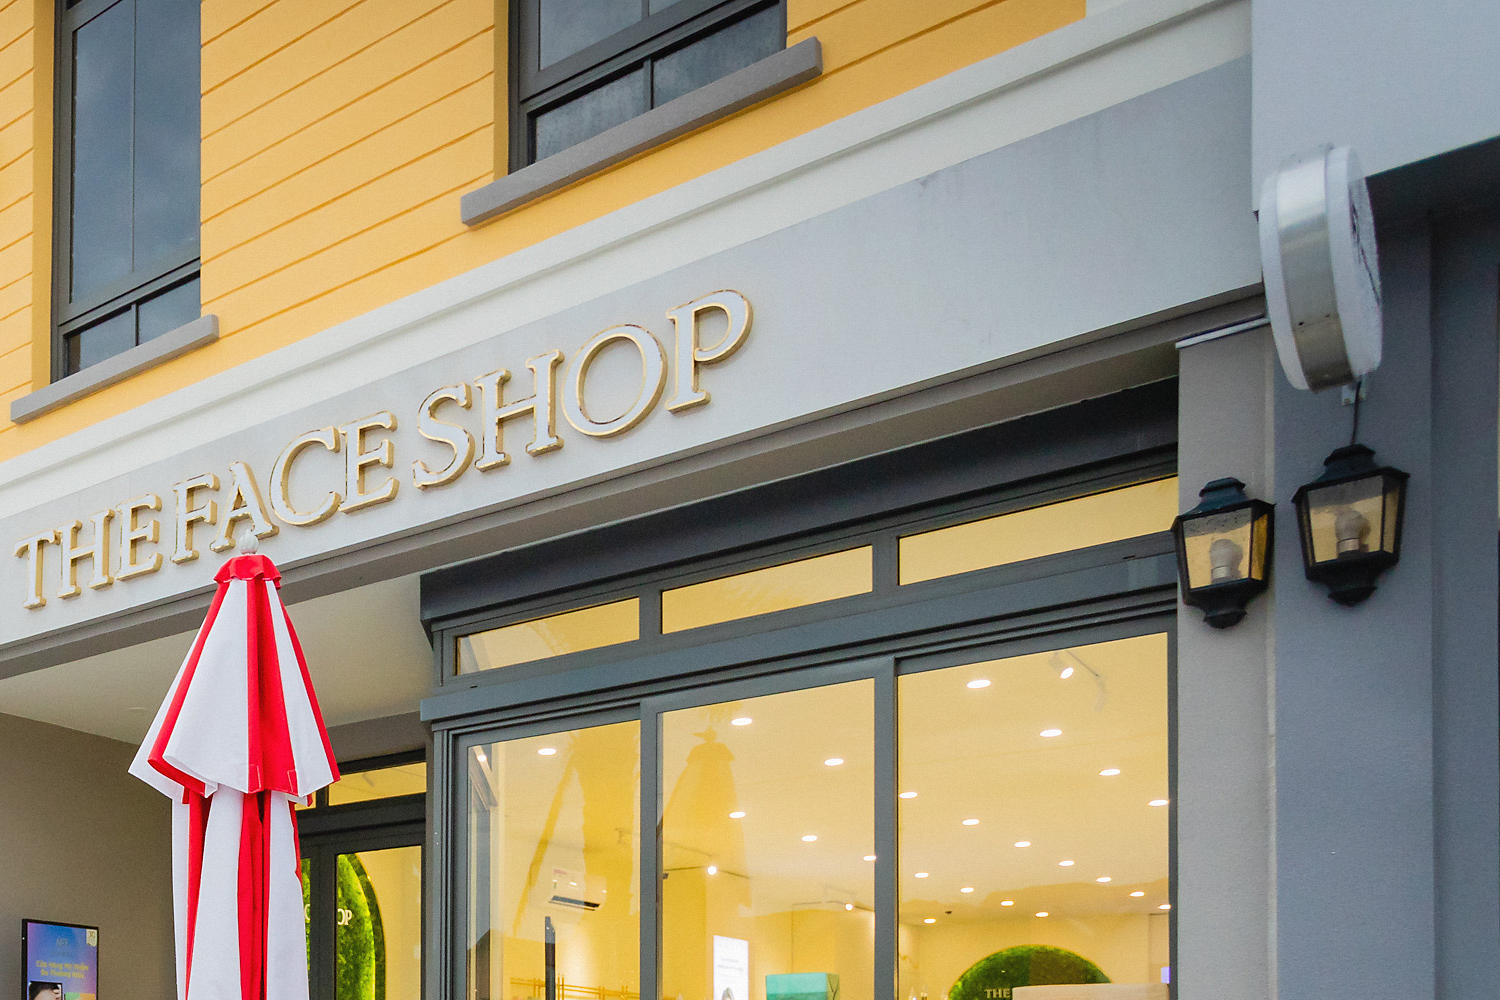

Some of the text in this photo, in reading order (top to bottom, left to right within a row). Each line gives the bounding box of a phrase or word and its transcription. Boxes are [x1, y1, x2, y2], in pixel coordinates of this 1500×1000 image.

[13, 288, 754, 610] THE FACE SHOP
[984, 988, 1011, 999] THE
